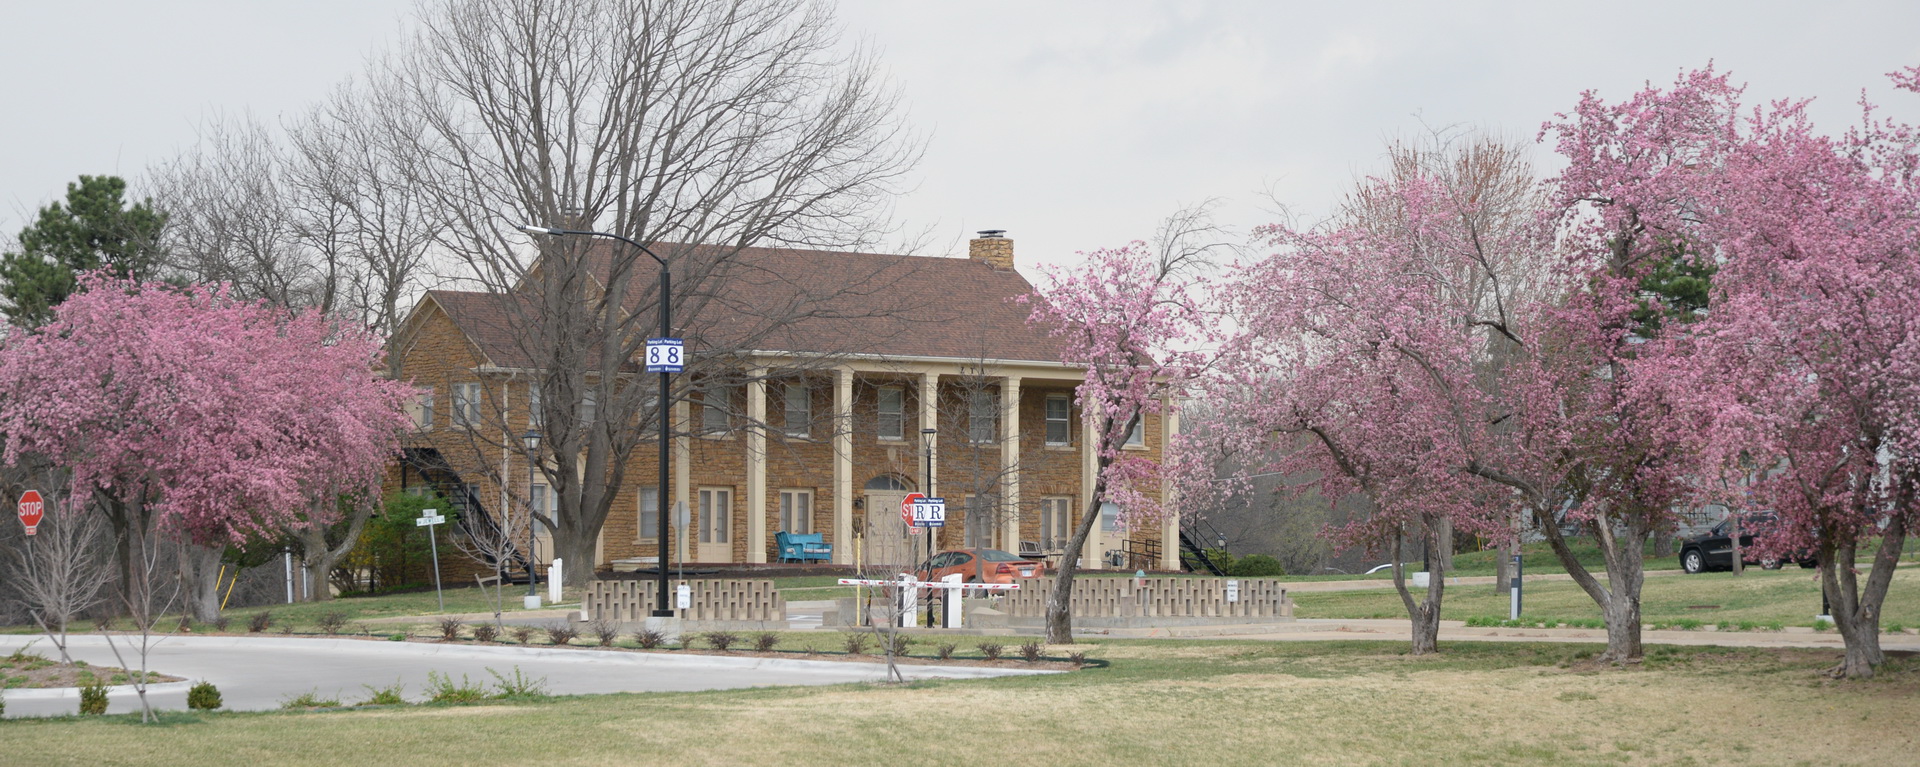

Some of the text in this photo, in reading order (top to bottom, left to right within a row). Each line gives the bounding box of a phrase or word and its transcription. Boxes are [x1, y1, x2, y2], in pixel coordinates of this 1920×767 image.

[650, 346, 660, 364] 8
[668, 346, 678, 364] 8
[20, 502, 41, 516] STOP
[903, 504, 914, 516] ST
[915, 505, 924, 520] R
[930, 505, 941, 520] R
